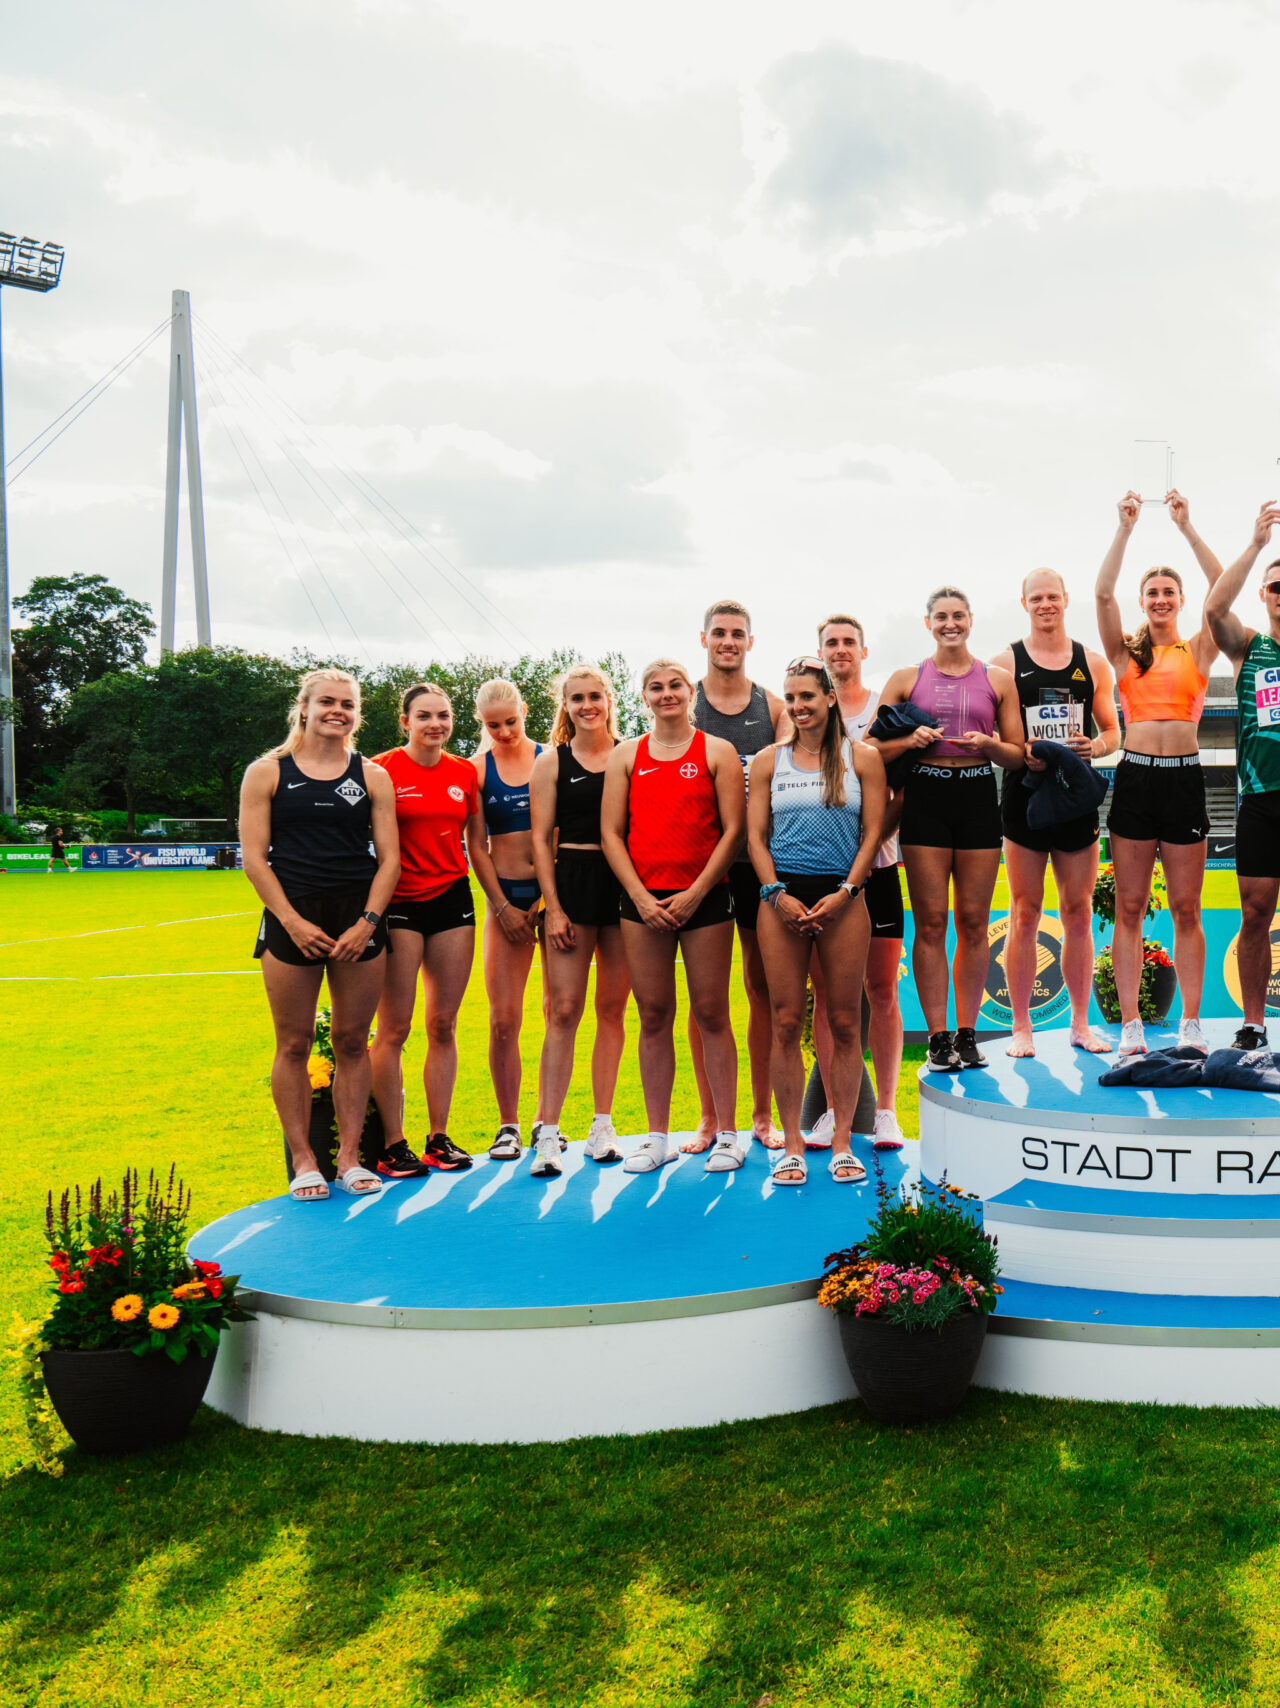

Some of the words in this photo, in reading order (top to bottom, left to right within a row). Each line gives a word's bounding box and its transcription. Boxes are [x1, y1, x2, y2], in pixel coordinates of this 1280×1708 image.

[1125, 752, 1151, 767] PUMA
[1153, 757, 1181, 768] PUMA
[918, 765, 953, 778] PRO
[960, 766, 991, 778] NIKE
[787, 781, 808, 789] TELIS
[341, 787, 361, 797] MTV
[158, 848, 176, 856] FISU
[177, 848, 206, 856] WORLD
[143, 856, 192, 865] UNIVERSITY
[988, 921, 1009, 937] LEVE
[992, 1007, 1013, 1020] WOR
[1029, 994, 1068, 1020] OMBINED
[1021, 1136, 1192, 1182] STADT
